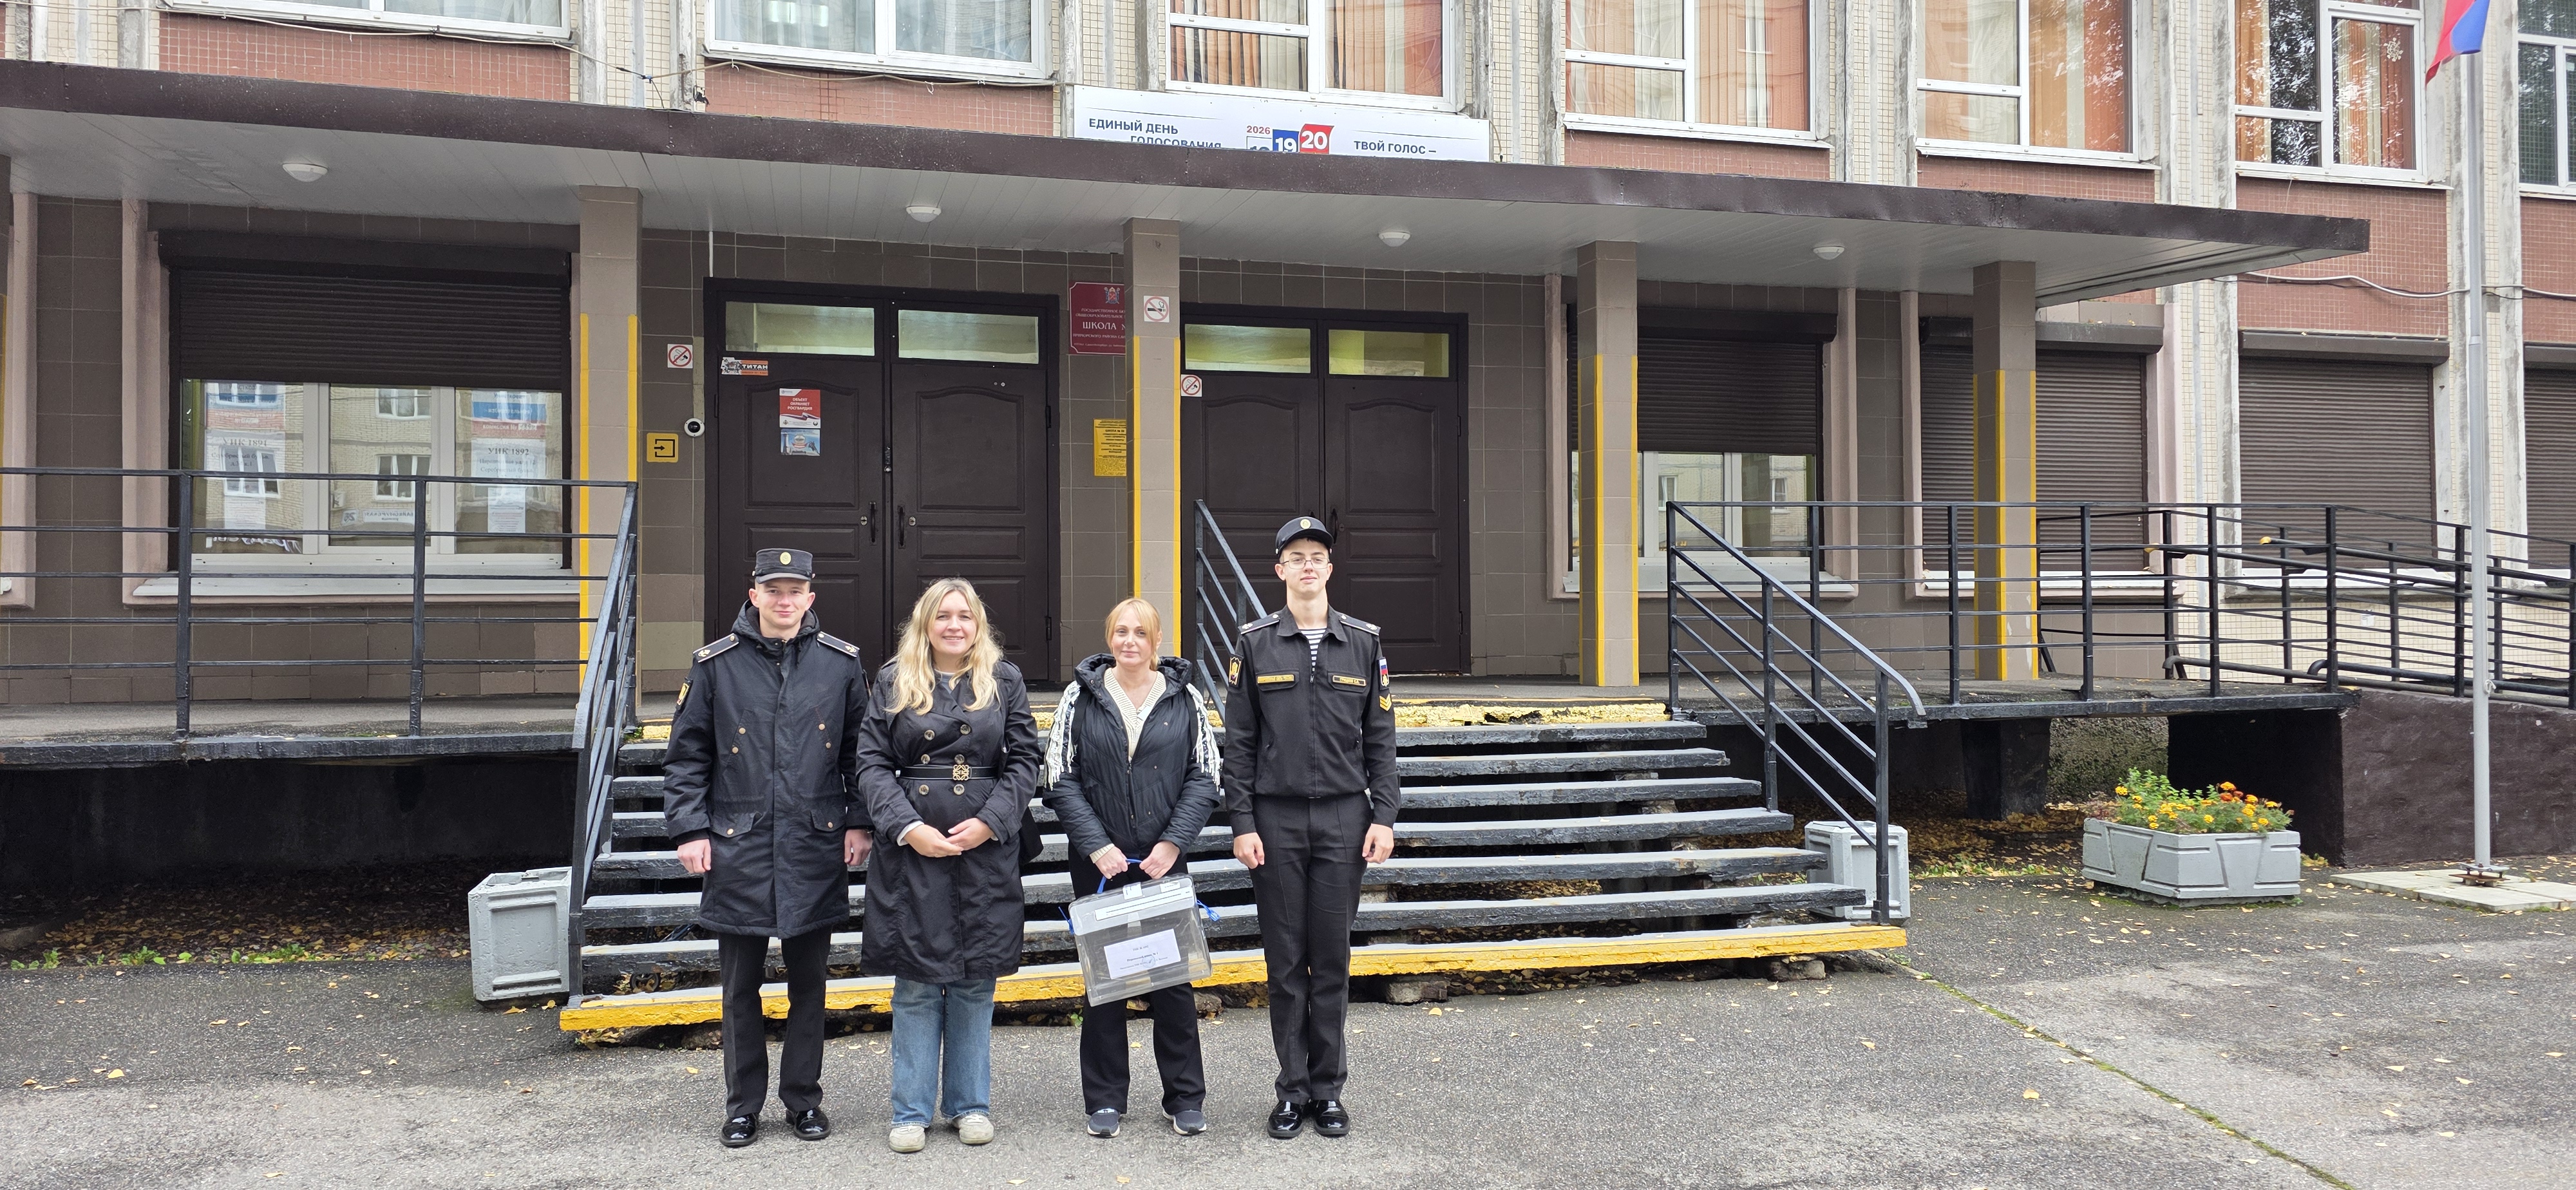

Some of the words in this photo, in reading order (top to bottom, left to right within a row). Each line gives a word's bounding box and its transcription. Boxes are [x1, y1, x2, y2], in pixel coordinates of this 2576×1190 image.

[1089, 118, 1142, 131] ЕДИНЫЙ
[1146, 123, 1179, 135] ДЕНЬ
[1247, 125, 1271, 135] 2026
[1275, 137, 1297, 152] 19
[1302, 130, 1328, 150] 20
[1354, 140, 1385, 151] ТВОЙ
[1388, 143, 1426, 154] ГОЛОС
[1083, 321, 1117, 330] ШКОЛА
